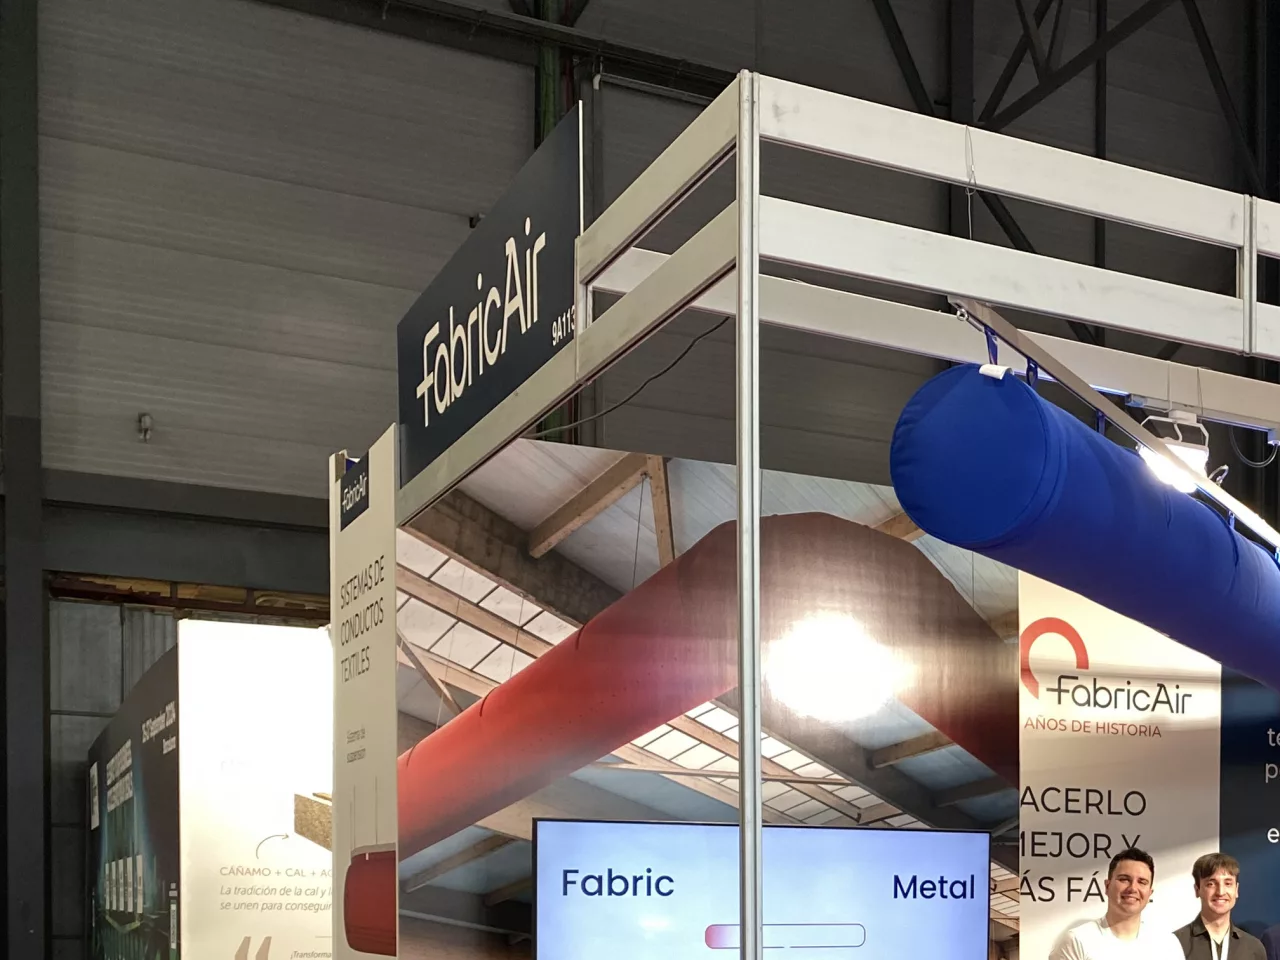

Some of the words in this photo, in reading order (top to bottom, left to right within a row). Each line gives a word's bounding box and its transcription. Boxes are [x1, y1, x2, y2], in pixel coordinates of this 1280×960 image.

[416, 217, 546, 428] FabricAir
[341, 564, 373, 610] SISTEMAS
[374, 555, 385, 587] DE
[340, 597, 385, 646] CONDUCTOS
[340, 646, 370, 683] TEXTILES
[1046, 674, 1193, 714] FabricAir
[1024, 715, 1067, 732] AÑOS
[1072, 719, 1092, 734] DE
[1096, 722, 1162, 738] HISTORIA
[1020, 786, 1147, 816] ACERLO
[220, 866, 271, 877] CÁÑAMO
[285, 867, 307, 877] CAL
[562, 867, 675, 897] Fabric
[1020, 869, 1056, 902] ÁS
[220, 885, 232, 896] La
[234, 885, 277, 896] tradición
[279, 886, 291, 896] de
[294, 886, 303, 896] la
[305, 887, 319, 897] cal
[319, 888, 327, 899] y
[893, 874, 976, 900] Metal
[220, 902, 232, 910] se
[234, 902, 259, 910] unen
[260, 902, 283, 912] para
[285, 901, 332, 913] conseguir
